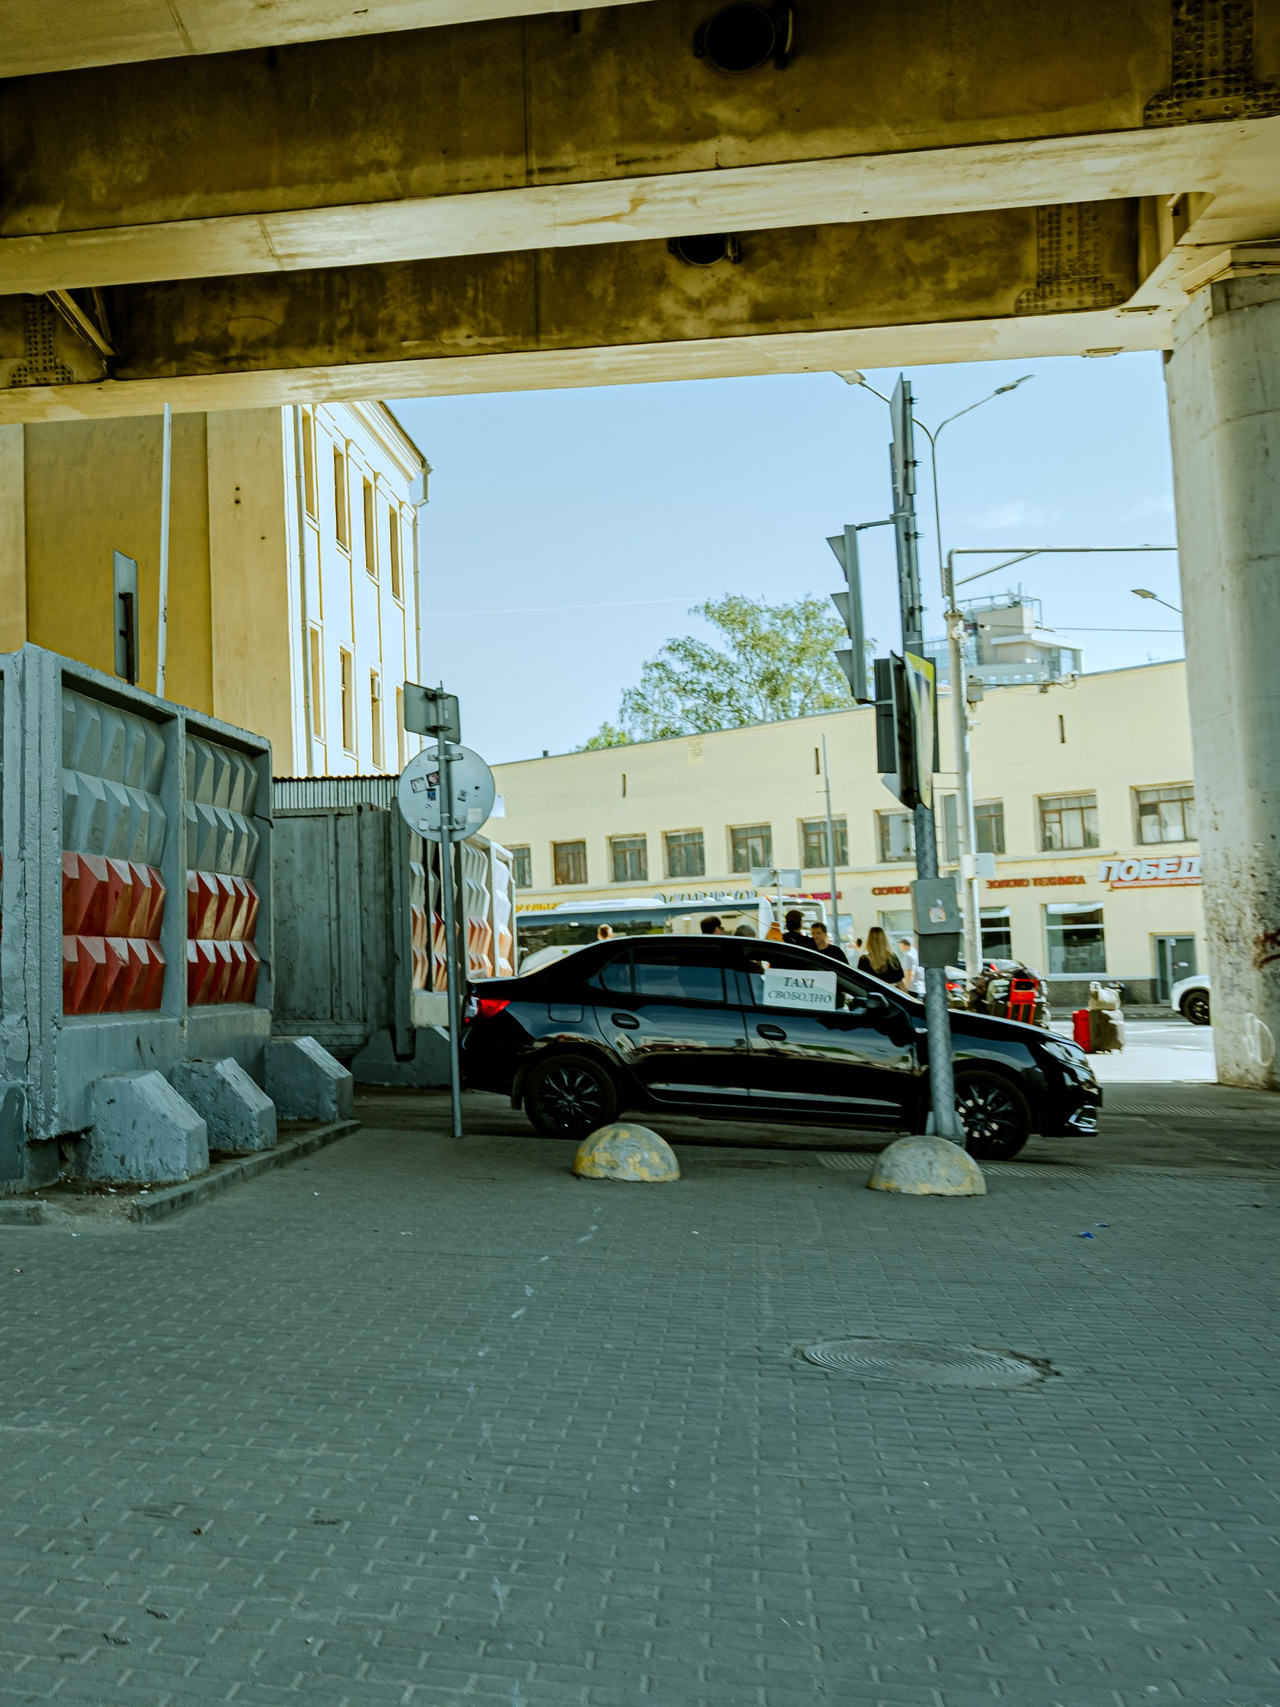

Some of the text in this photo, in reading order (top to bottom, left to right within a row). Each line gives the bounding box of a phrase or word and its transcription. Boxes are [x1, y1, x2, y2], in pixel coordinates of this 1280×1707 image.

[1031, 875, 1086, 887] ТЕХНИКА
[784, 976, 816, 989] TAXI
[767, 990, 832, 1004] СВОБОДНО
